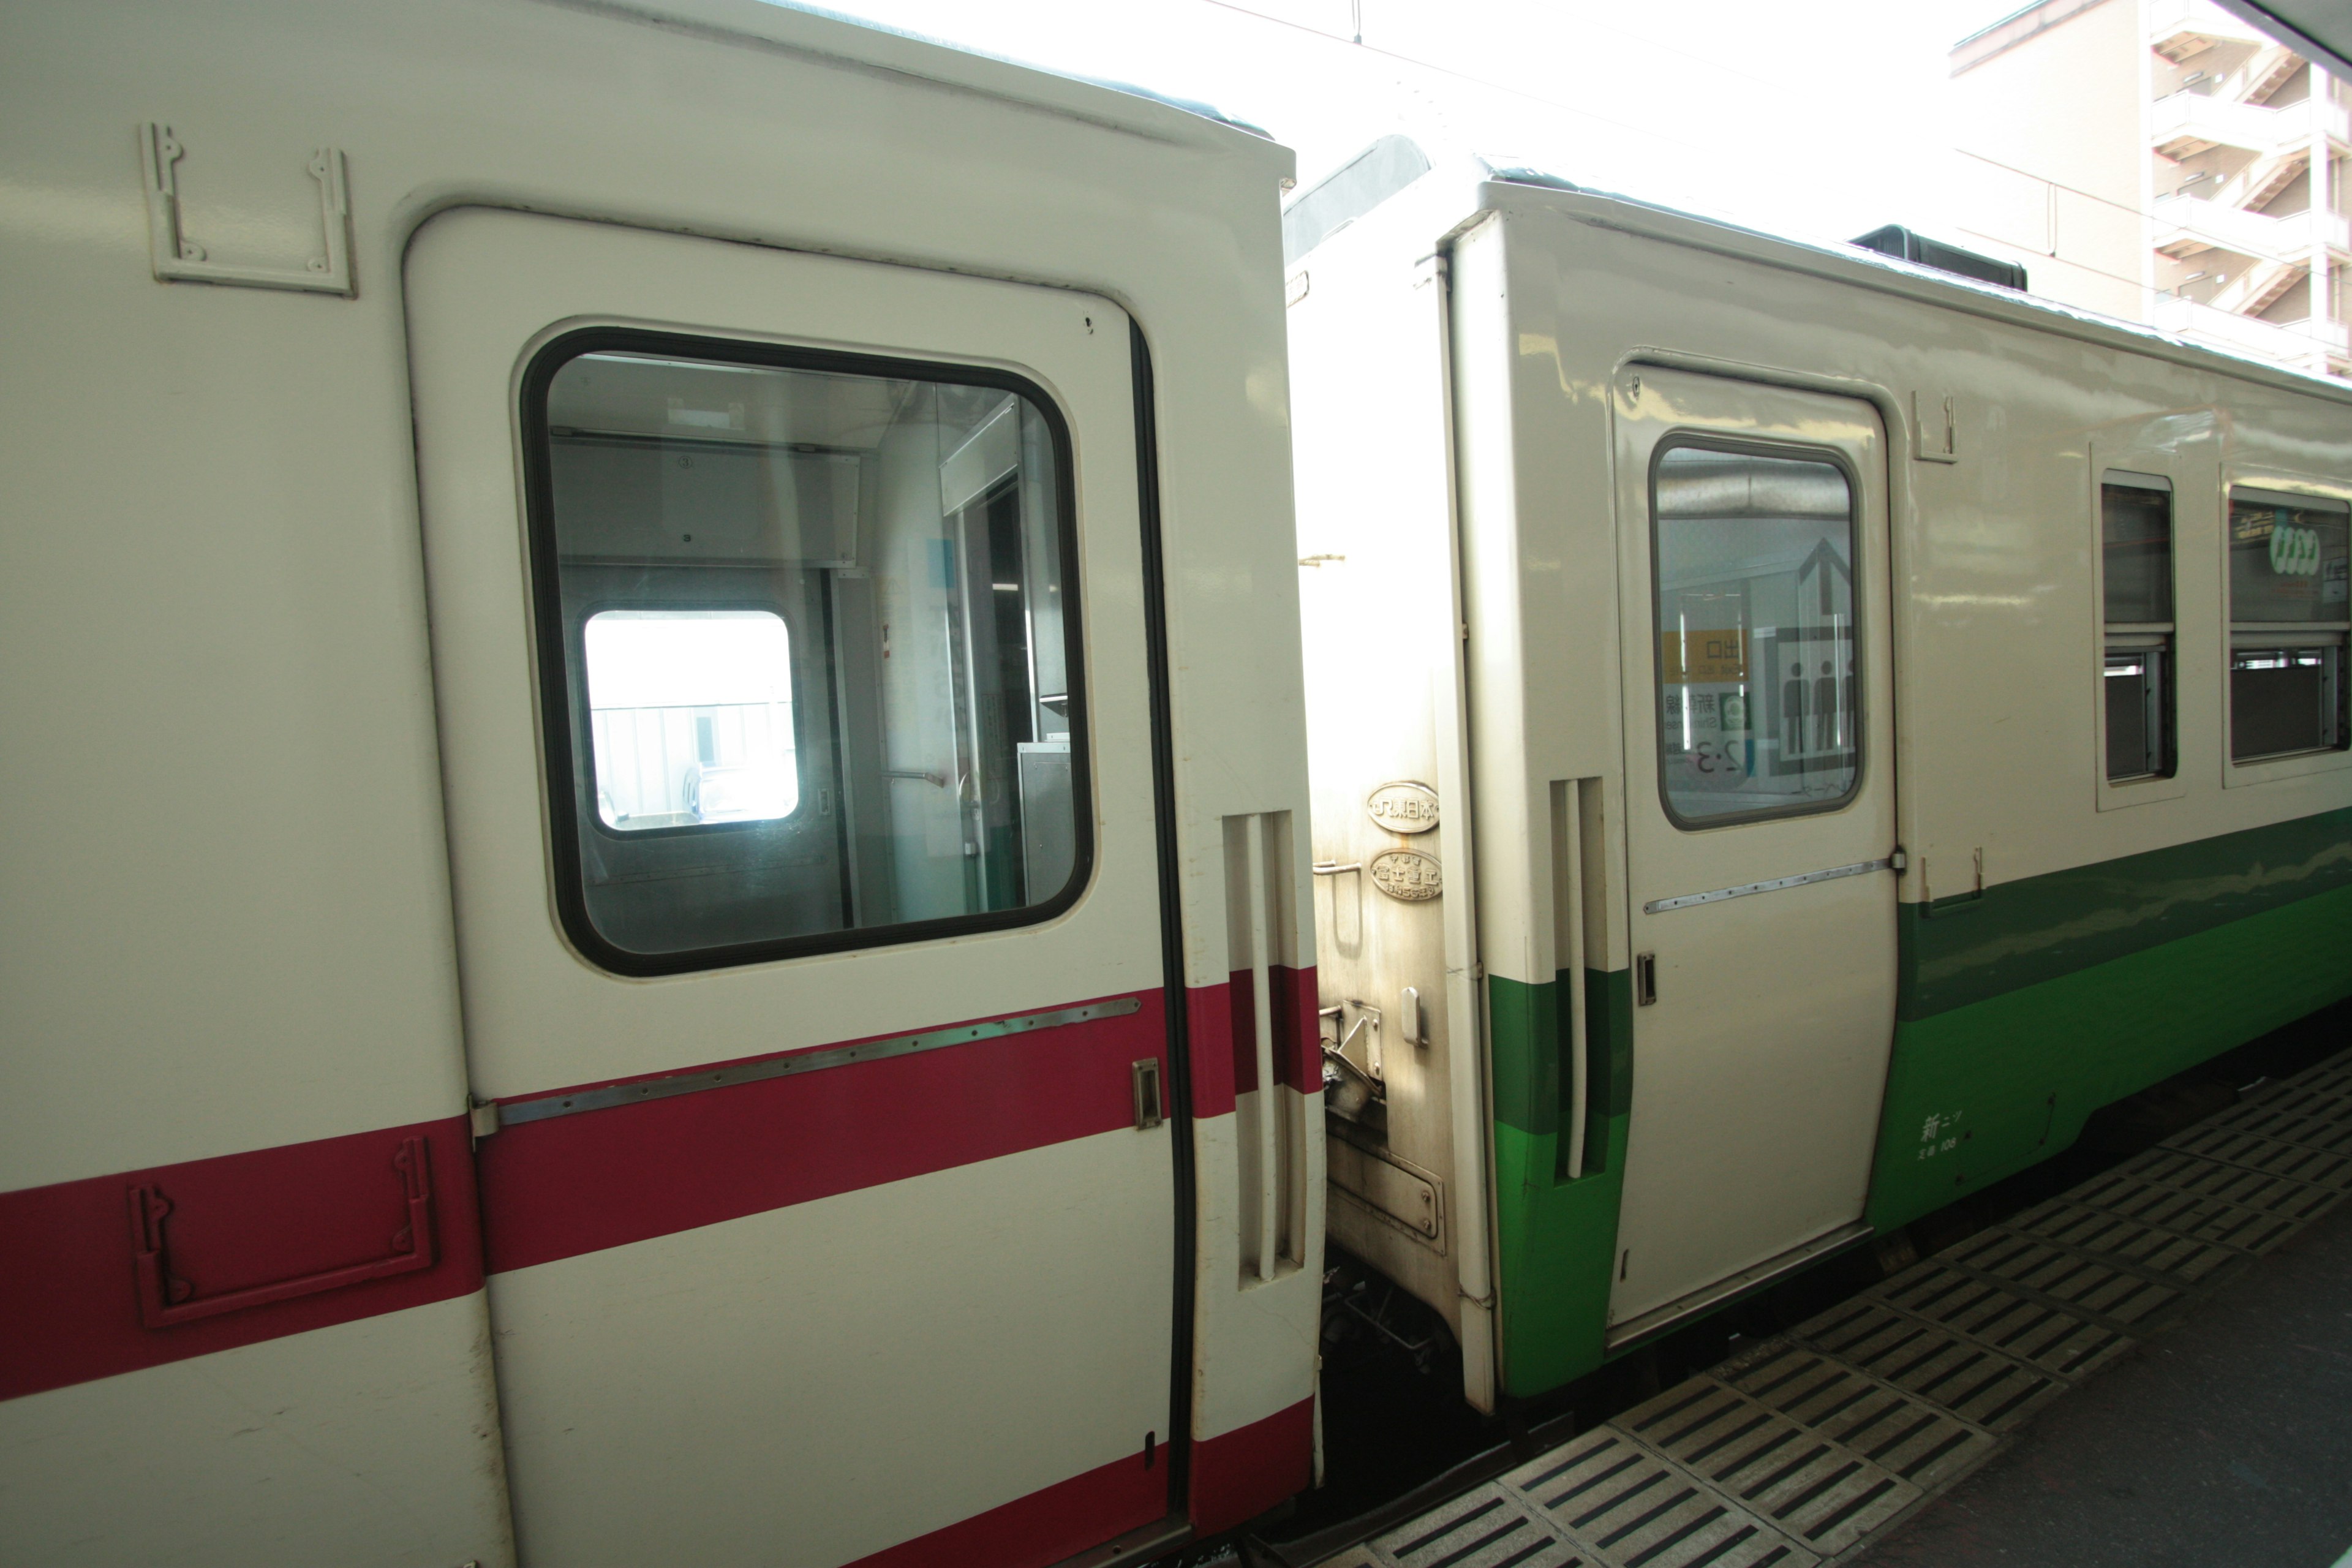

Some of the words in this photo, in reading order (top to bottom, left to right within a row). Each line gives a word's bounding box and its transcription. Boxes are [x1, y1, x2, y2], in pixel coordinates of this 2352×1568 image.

[1373, 798, 1434, 820] JR東日本
[1378, 864, 1439, 886] 富士重工
